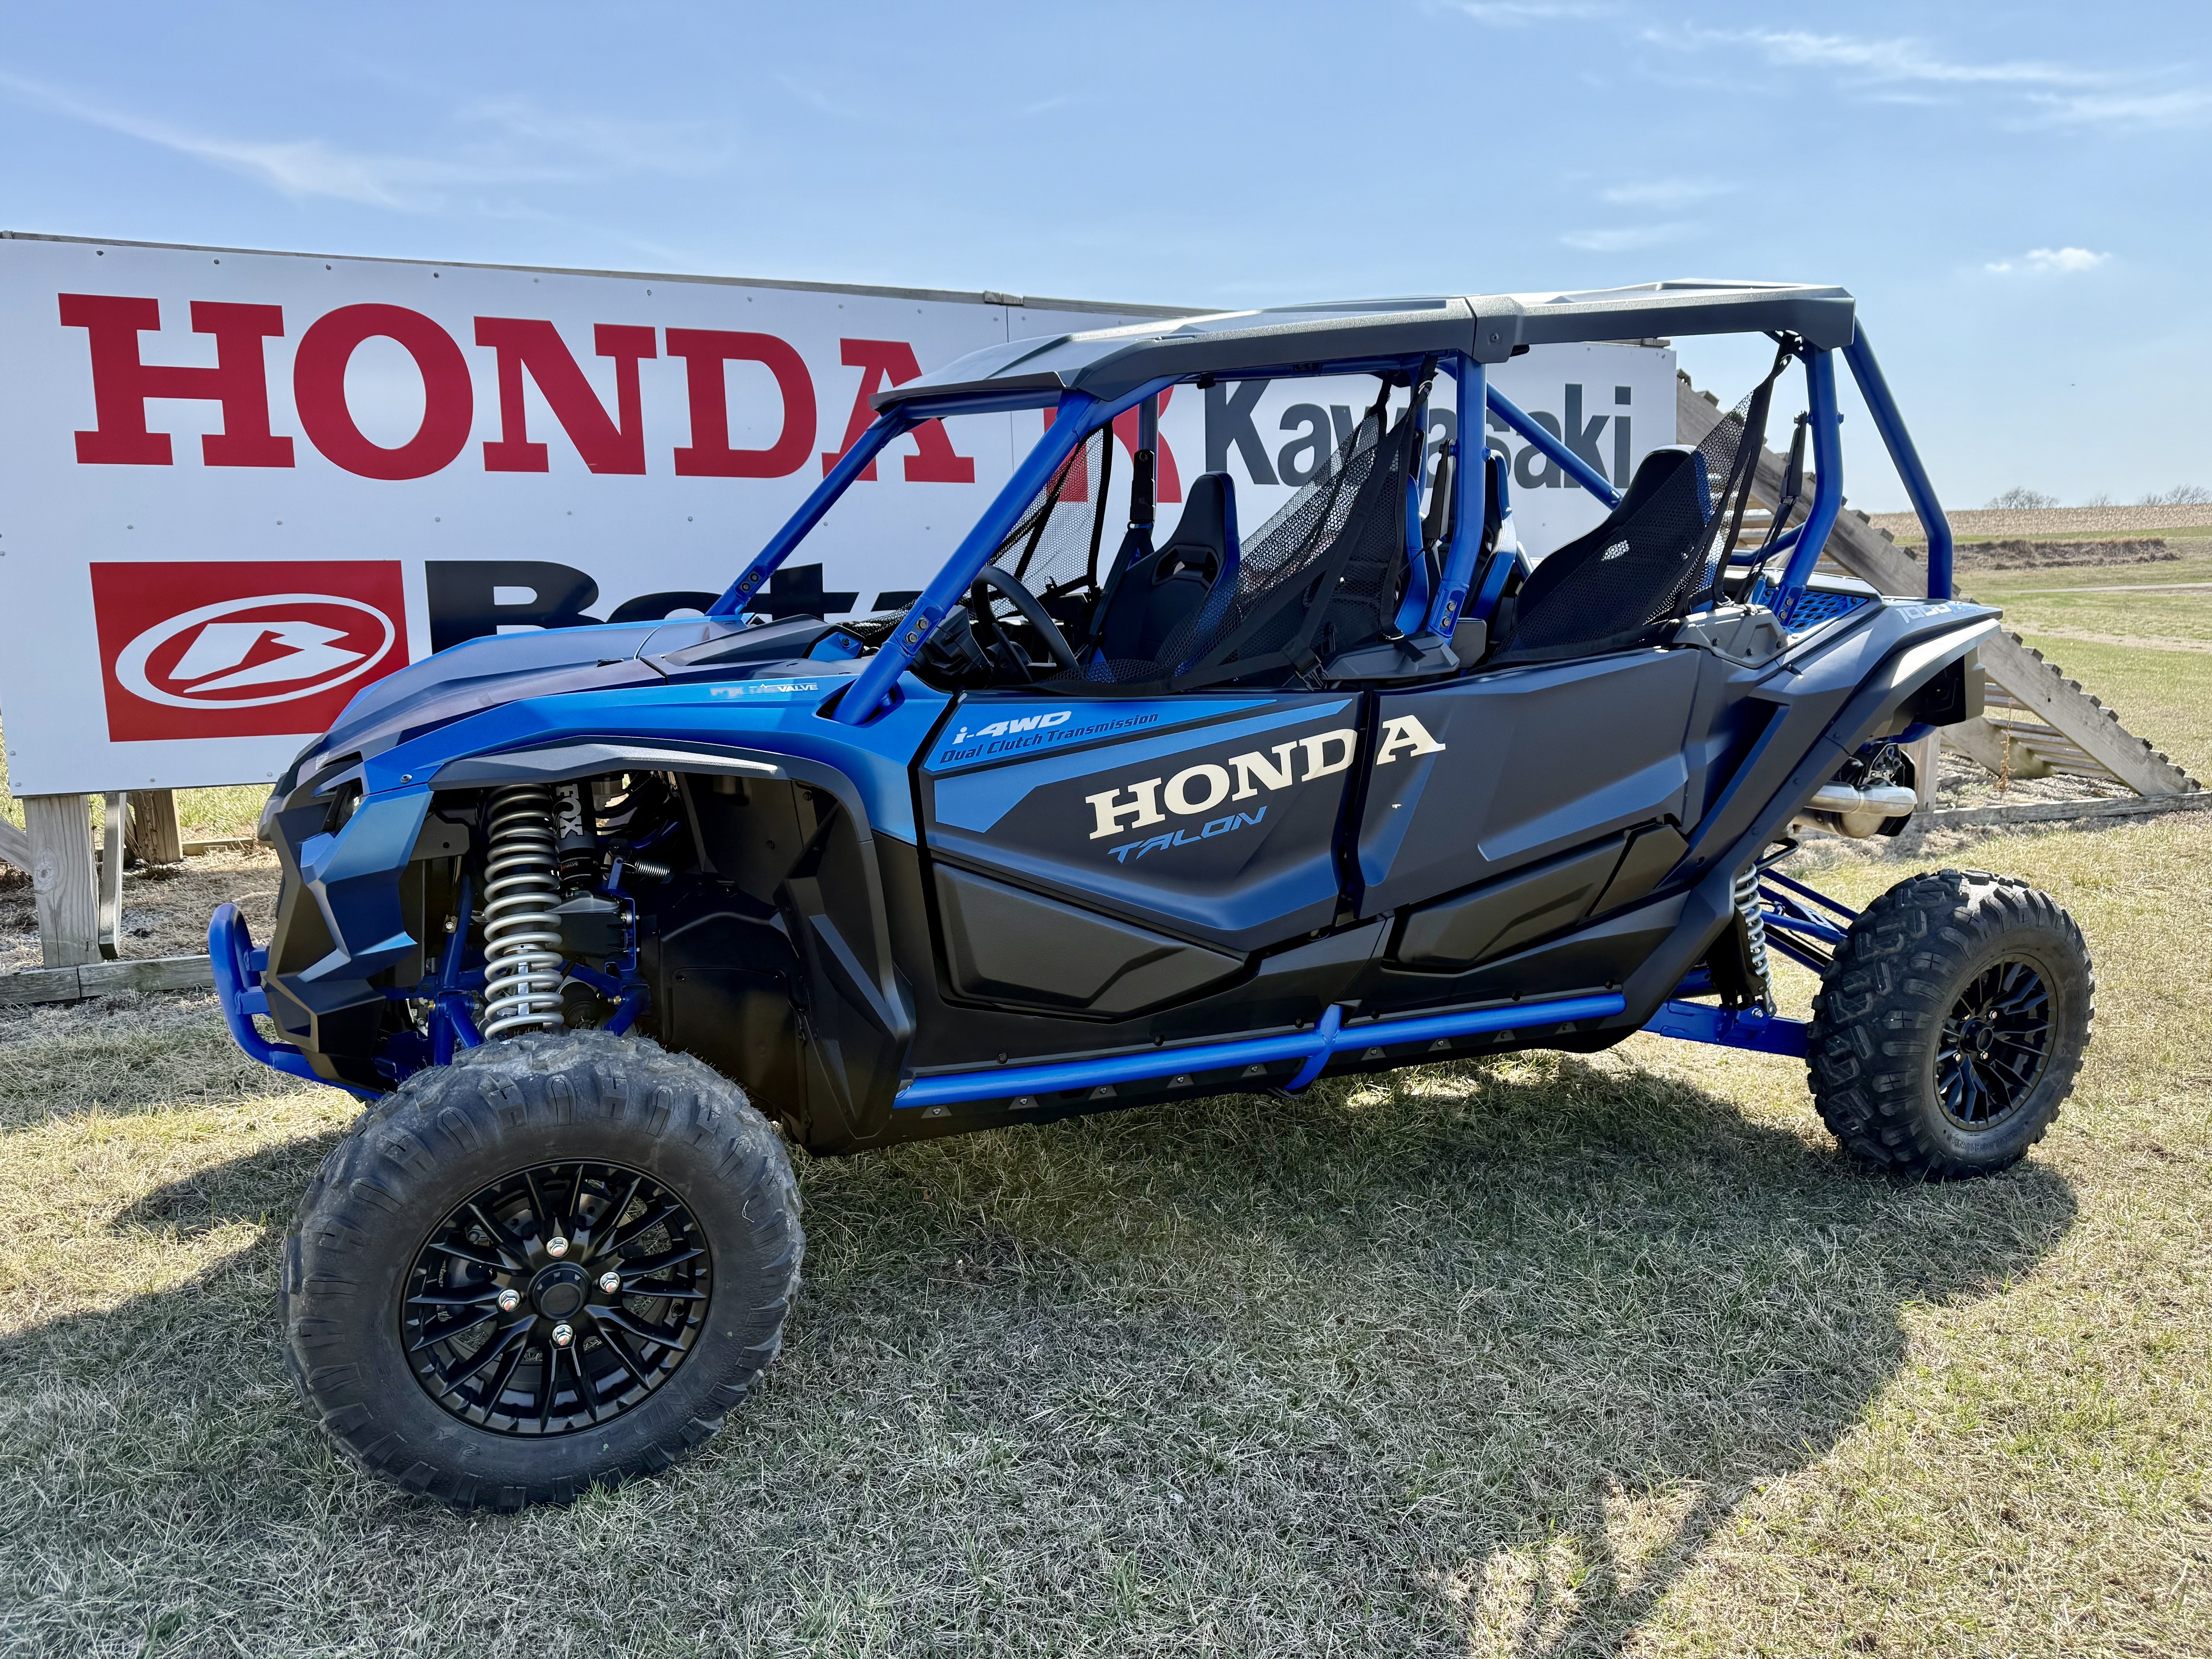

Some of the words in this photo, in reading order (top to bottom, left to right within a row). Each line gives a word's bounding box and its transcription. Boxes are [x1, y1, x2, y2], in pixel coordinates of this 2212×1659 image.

[58, 292, 975, 483] HONDA
[940, 744, 984, 764] Dual
[986, 733, 1042, 754] Clutch
[1047, 713, 1159, 742] Transmission
[952, 711, 1072, 744] i-4WD
[1085, 714, 1446, 840] HONDA
[553, 783, 584, 839] FOX
[1108, 805, 1267, 864] TALON
